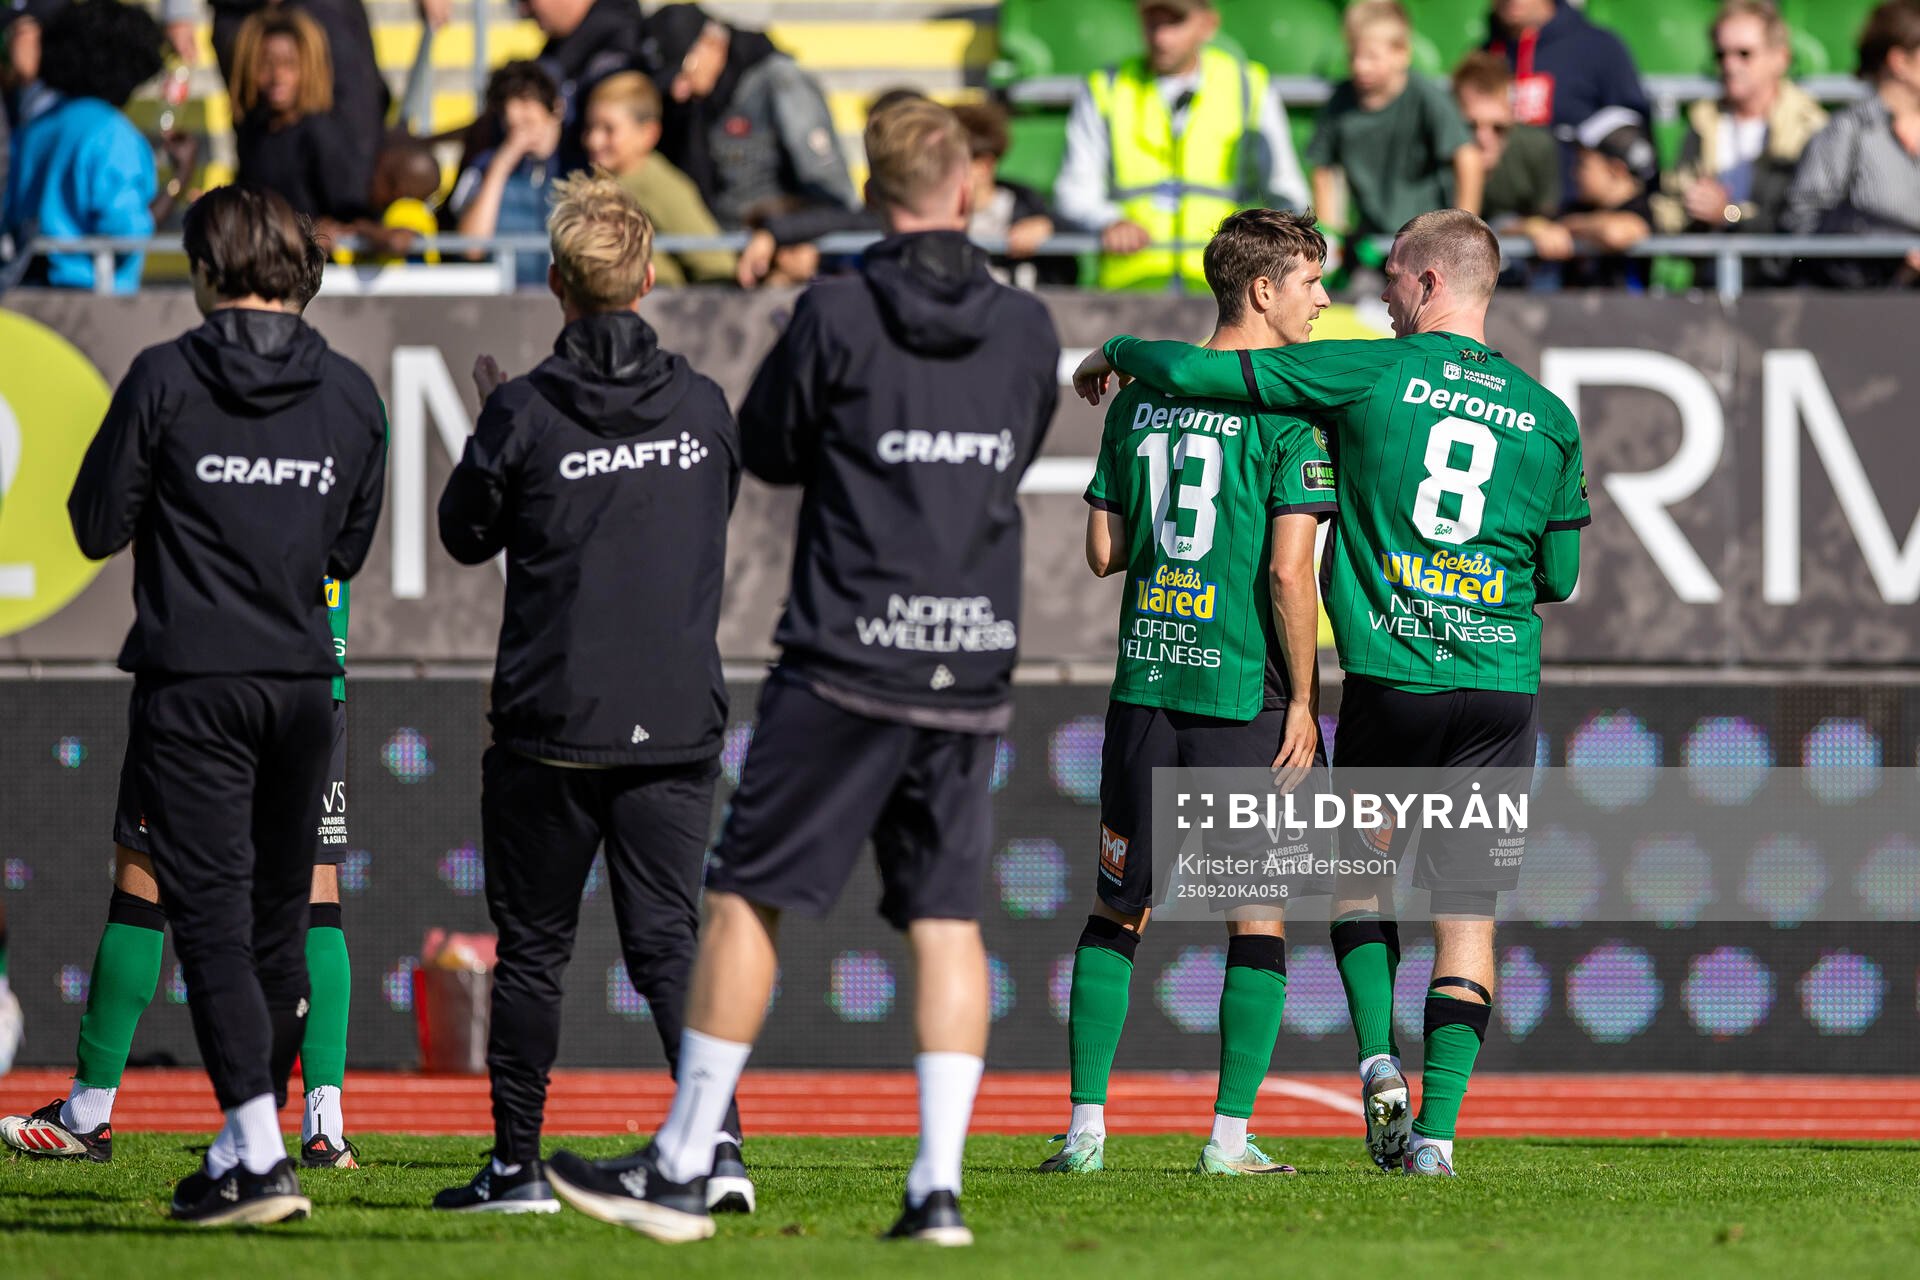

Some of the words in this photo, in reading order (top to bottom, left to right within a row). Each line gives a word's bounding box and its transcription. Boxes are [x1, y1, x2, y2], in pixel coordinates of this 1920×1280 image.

[1463, 368, 1507, 387] VARBERGS
[1463, 375, 1503, 393] KOMMUN
[1132, 402, 1242, 437] Derome
[1402, 377, 1536, 432] Derome
[559, 439, 677, 480] CRAFT
[877, 429, 1000, 466] CRAFT
[196, 453, 321, 488] CRAFT
[1412, 416, 1498, 545] 8
[1137, 432, 1223, 562] 13
[1155, 564, 1202, 590] Gekås
[1381, 553, 1505, 605] Ullared
[1432, 549, 1491, 577] Gekås
[1137, 580, 1216, 620] llared
[1390, 594, 1487, 625] NORDIC
[1368, 610, 1517, 644] WELLNESS
[1266, 843, 1309, 857] VARBERGS
